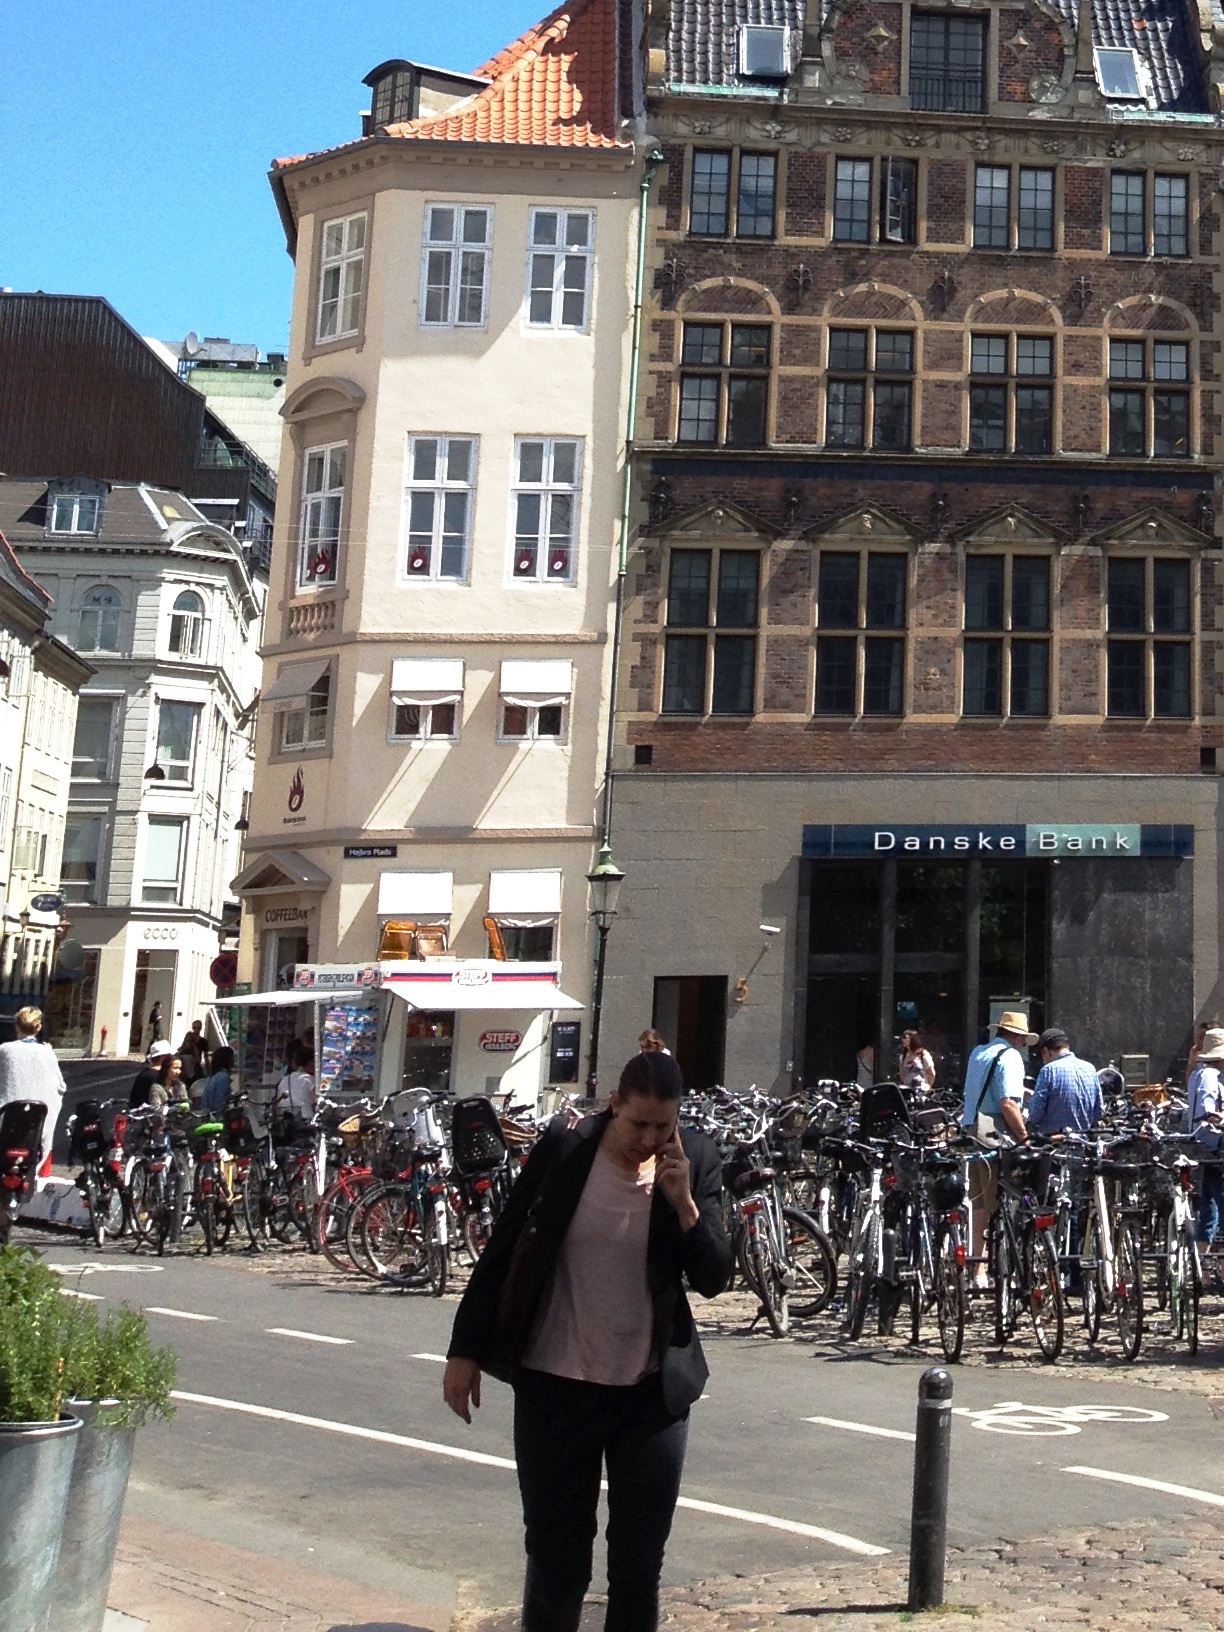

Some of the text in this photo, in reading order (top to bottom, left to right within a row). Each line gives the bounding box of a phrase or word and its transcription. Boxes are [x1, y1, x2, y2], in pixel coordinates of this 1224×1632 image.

[873, 831, 1131, 851] Danske Bank
[143, 927, 179, 940] ecco
[486, 1032, 517, 1043] STEFF
